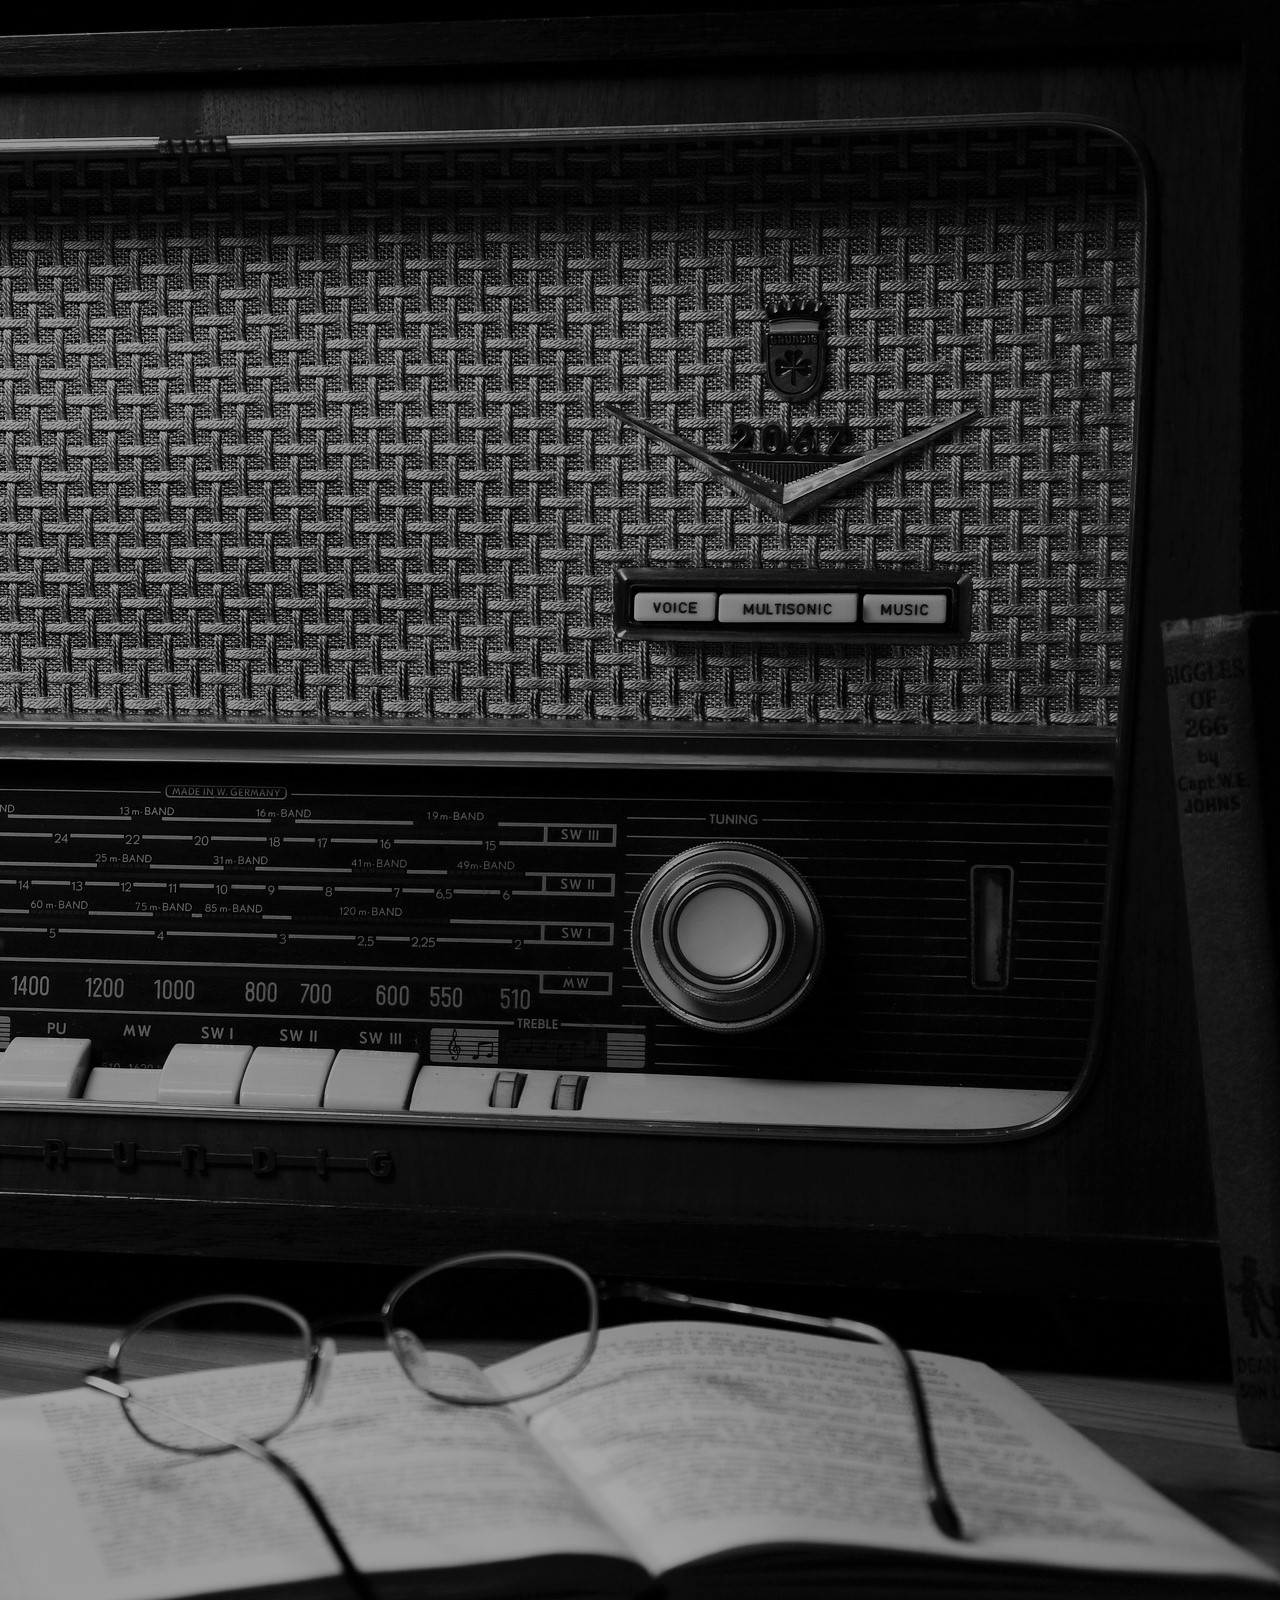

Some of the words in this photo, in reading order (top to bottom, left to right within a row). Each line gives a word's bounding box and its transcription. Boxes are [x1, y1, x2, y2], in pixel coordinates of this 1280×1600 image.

[652, 601, 698, 615] VOICE
[742, 602, 832, 616] MULTISONIC
[880, 603, 929, 617] MUSIC
[1189, 688, 1218, 710] OF
[1185, 716, 1228, 738] 266
[1197, 749, 1220, 768] by
[171, 787, 200, 796] MADE
[202, 787, 214, 796] IN
[216, 788, 229, 796] W.
[230, 787, 280, 797] GERMANY
[1183, 796, 1241, 813] JOHNS
[709, 813, 758, 825] TUNING
[560, 828, 583, 841] SW
[588, 829, 600, 841] III
[54, 833, 69, 844] 24
[125, 834, 141, 845] 22
[194, 835, 210, 847] 20
[268, 836, 281, 848] 18
[317, 837, 328, 848] 17
[379, 838, 392, 850] 16
[484, 840, 497, 851] 15
[17, 880, 30, 890] 14
[71, 880, 83, 892] 13
[120, 881, 132, 893] 12
[168, 883, 177, 894] 11
[215, 884, 228, 895] 10
[267, 885, 276, 896] 9
[324, 886, 333, 898] 8
[393, 887, 401, 898] 7
[502, 889, 511, 901] 6
[560, 878, 582, 890] SW
[49, 927, 57, 939] 5
[156, 930, 165, 941] 4
[278, 933, 287, 945] 3
[514, 939, 522, 950] 2
[561, 927, 583, 939] SW
[562, 977, 589, 989] MW
[11, 975, 50, 997] 1400
[85, 977, 125, 999] 1200
[153, 979, 195, 1001] 1000
[245, 981, 278, 1003] 800
[300, 983, 332, 1005] 700
[375, 984, 410, 1007] 600
[429, 986, 463, 1009] 550
[500, 987, 531, 1010] 510
[47, 1022, 67, 1035] PU
[122, 1024, 152, 1037] MW
[516, 1017, 559, 1030] TREBLE
[201, 1026, 225, 1040] SW
[279, 1028, 303, 1042] SW
[359, 1031, 383, 1045] SW
[389, 1032, 402, 1045] III
